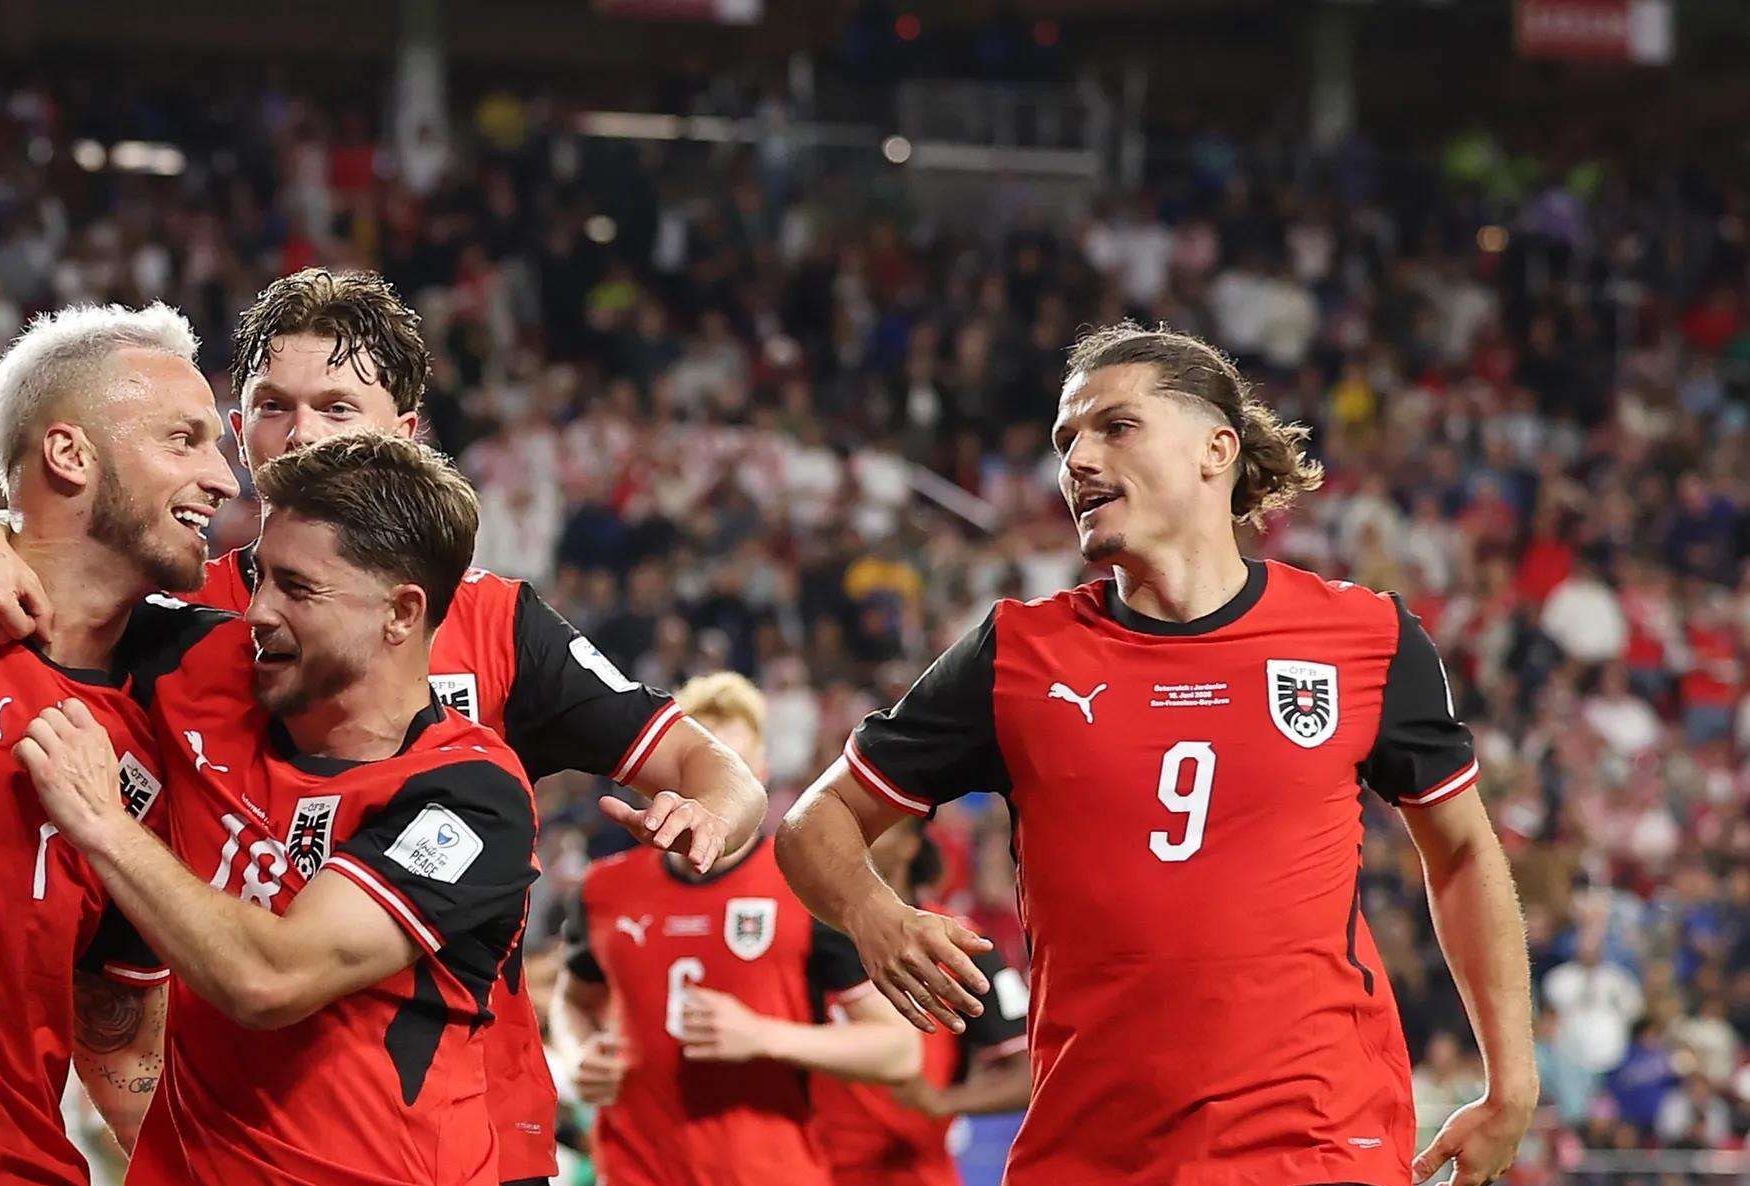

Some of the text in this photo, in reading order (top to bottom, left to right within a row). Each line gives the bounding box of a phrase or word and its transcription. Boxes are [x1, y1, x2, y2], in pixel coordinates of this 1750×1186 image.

[1149, 741, 1217, 862] 9
[209, 813, 288, 912] 18
[410, 849, 438, 874] PEACE
